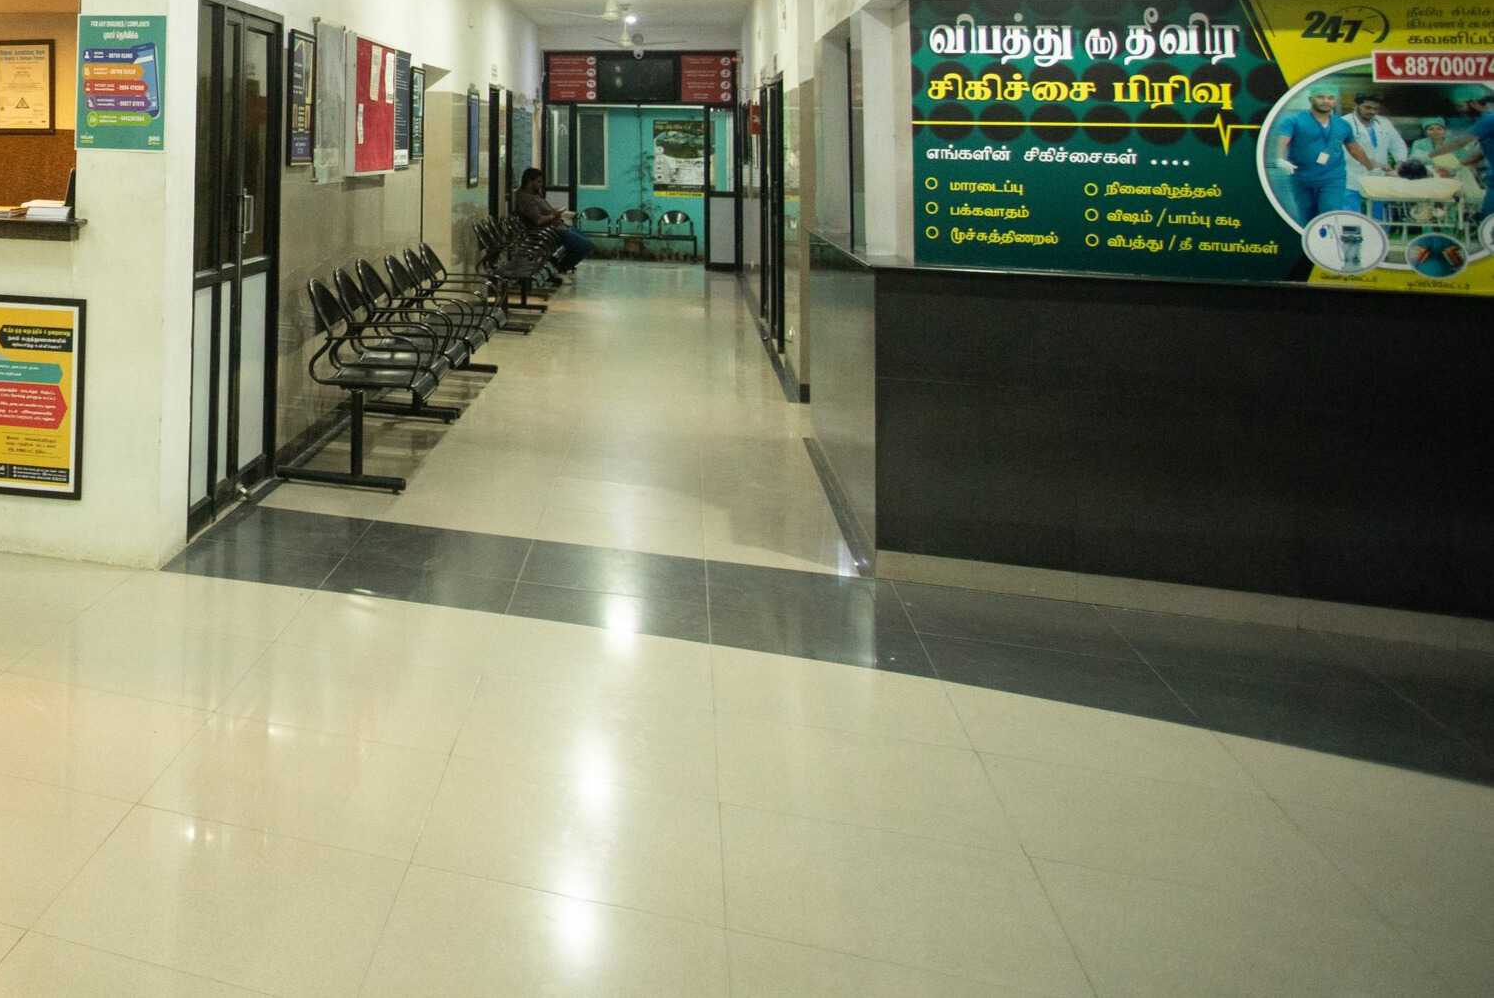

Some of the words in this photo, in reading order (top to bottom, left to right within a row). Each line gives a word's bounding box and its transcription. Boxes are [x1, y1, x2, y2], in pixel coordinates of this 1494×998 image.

[928, 12, 1074, 67] விபத்து
[1124, 7, 1240, 66] தீவிர
[926, 72, 1098, 102] சிகிச்சை
[1113, 74, 1232, 110] பிரிவு
